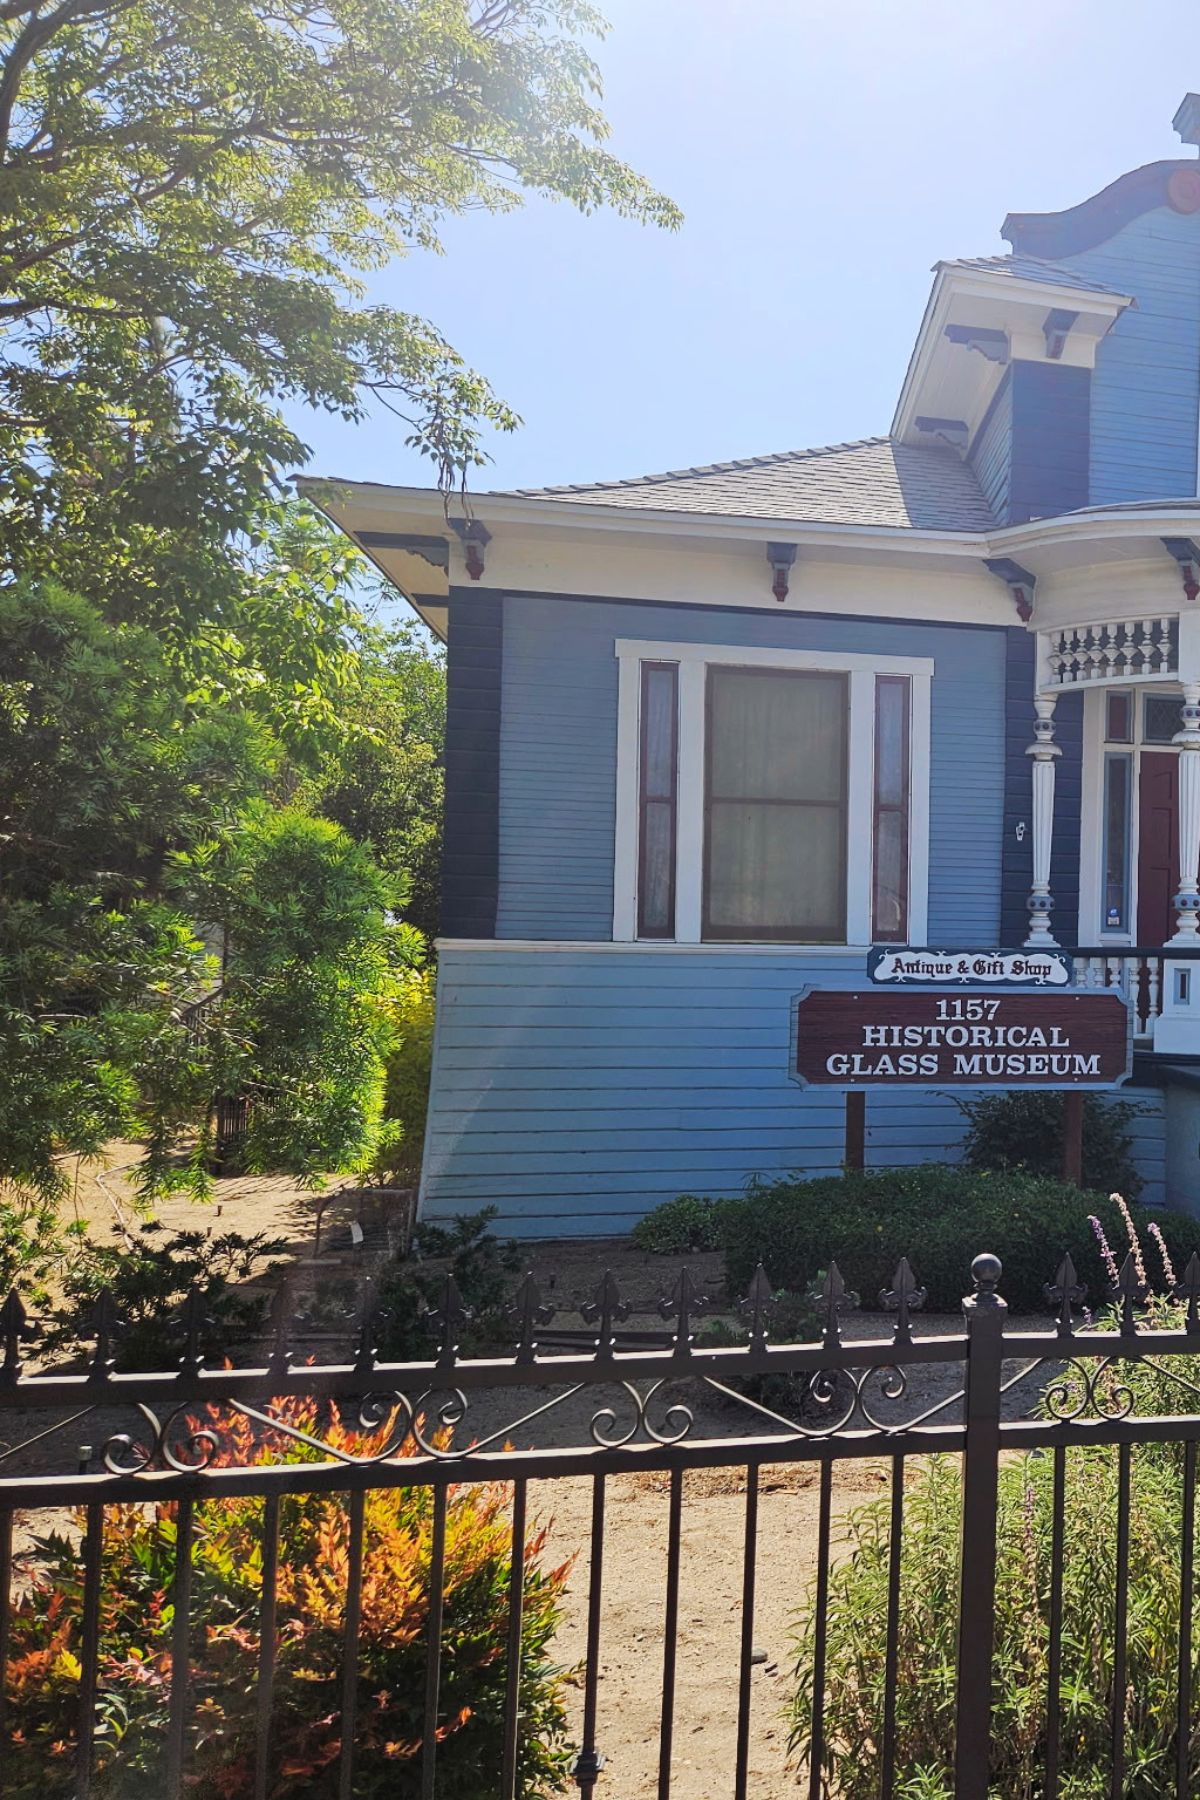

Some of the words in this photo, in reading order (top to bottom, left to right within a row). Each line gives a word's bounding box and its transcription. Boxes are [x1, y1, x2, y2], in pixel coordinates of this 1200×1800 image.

[891, 957, 953, 978] Antique
[957, 960, 970, 975] &
[972, 959, 1004, 976] Gift
[1010, 960, 1052, 977] Shop
[935, 999, 1001, 1021] 1157
[862, 1025, 1070, 1048] HISTORICAL
[826, 1053, 939, 1076] GLASS
[953, 1053, 1101, 1075] MUSEUM
